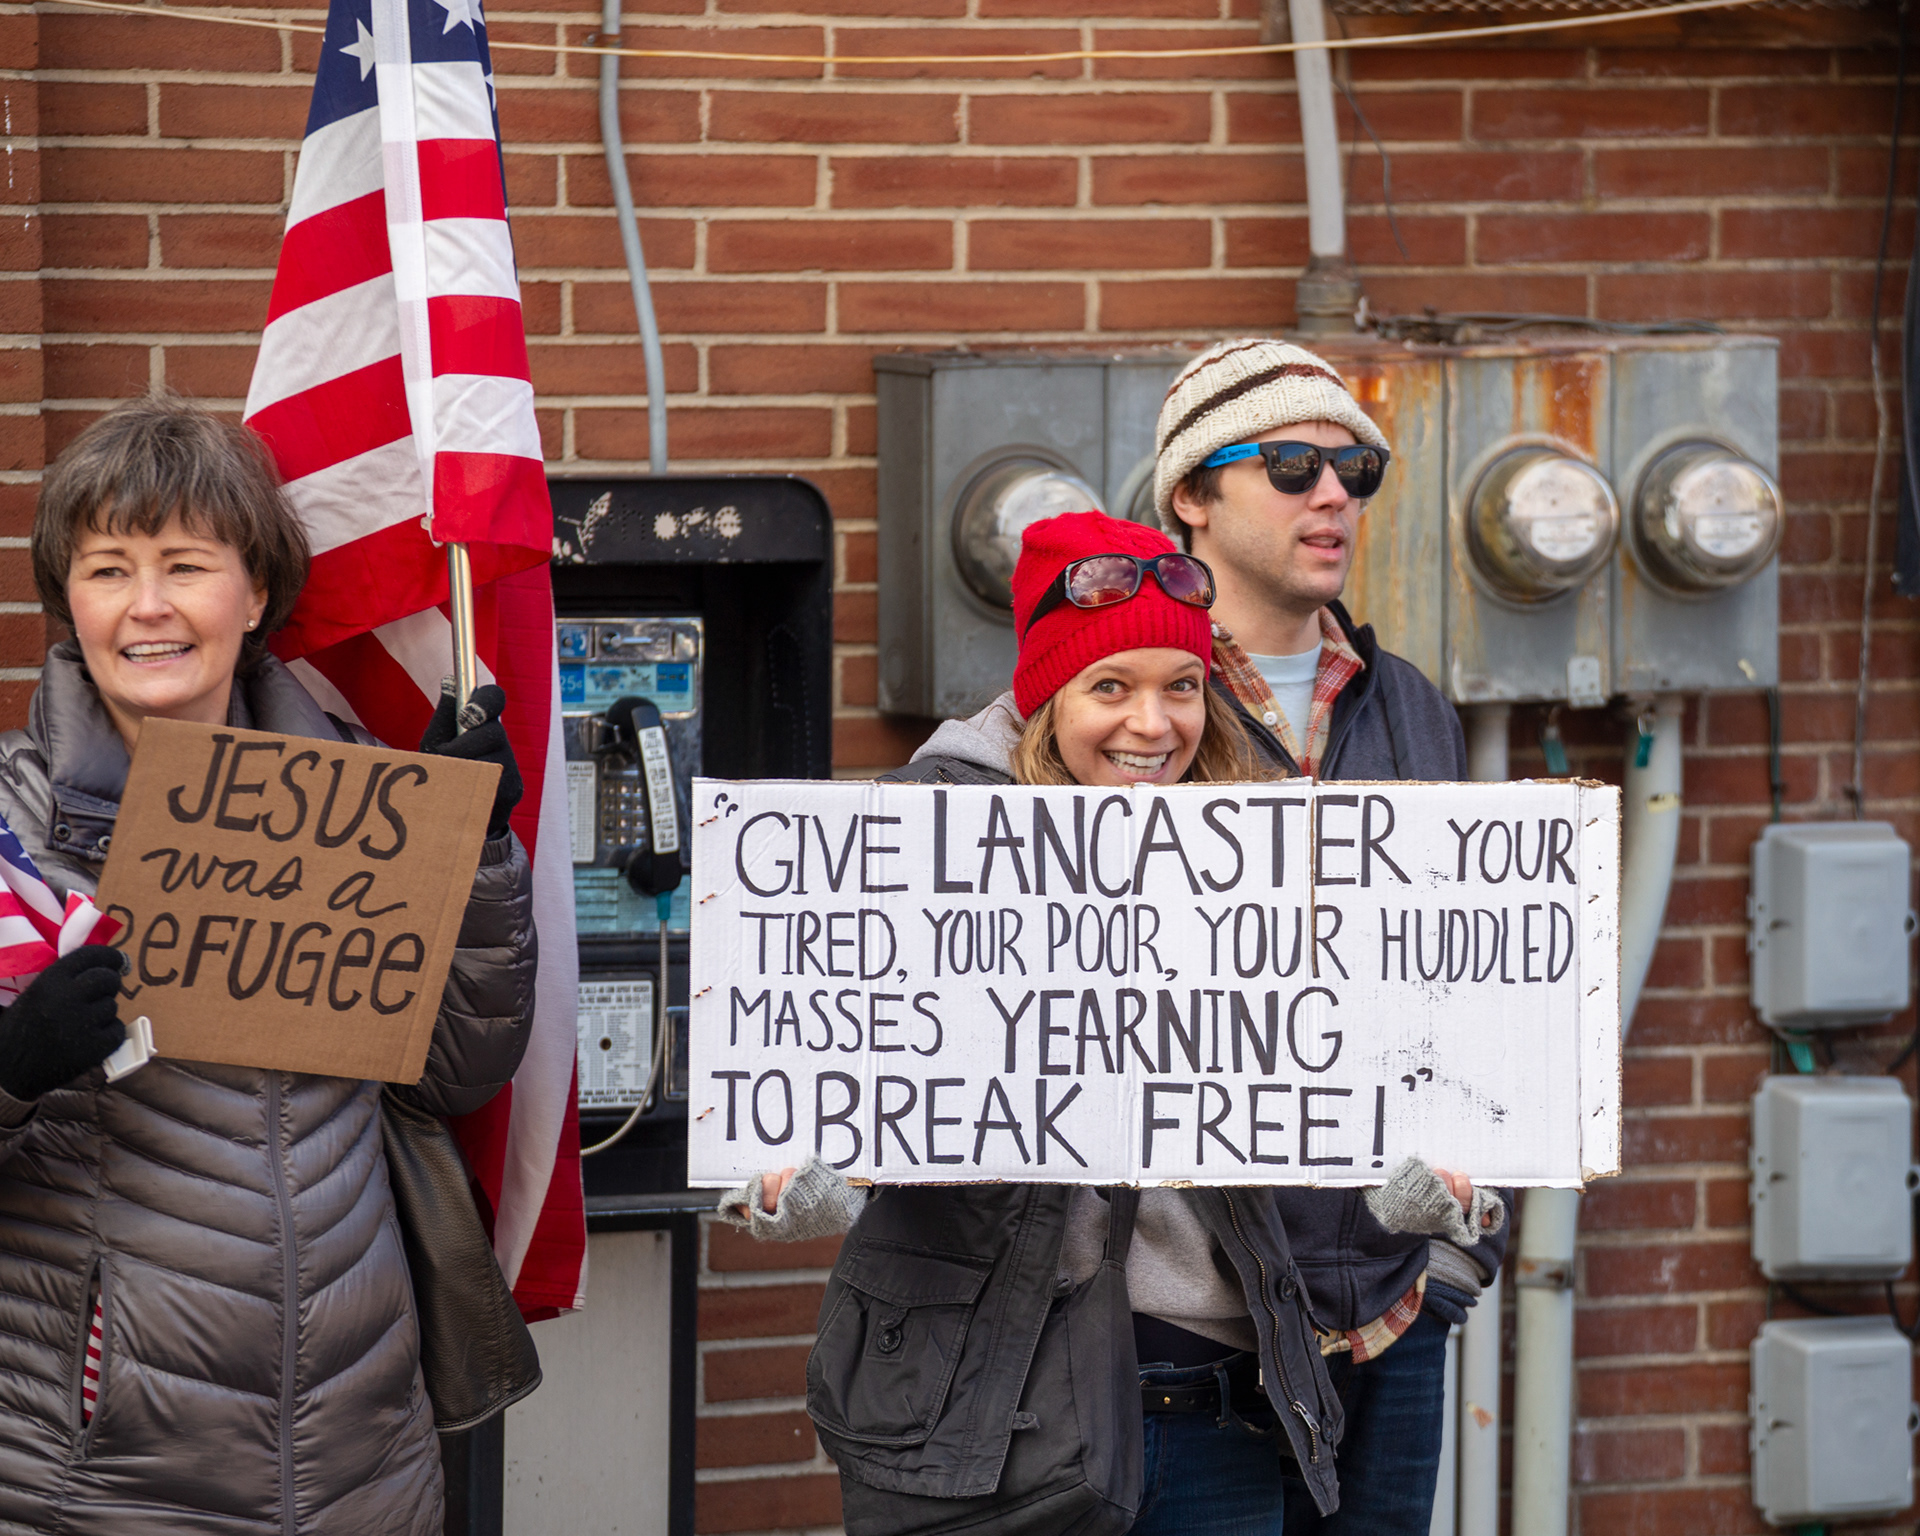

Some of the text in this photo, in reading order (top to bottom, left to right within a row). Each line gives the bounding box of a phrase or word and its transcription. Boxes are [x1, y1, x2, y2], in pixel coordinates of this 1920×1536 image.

[166, 733, 429, 861] JESUS
[932, 789, 1412, 898] LANCASTER
[1446, 817, 1577, 885] YOUR
[141, 847, 408, 919] was a
[739, 901, 1575, 984] TIRED, YOUR POOR, YOUR HUDDLED
[729, 986, 943, 1057] MASSES
[986, 986, 1343, 1076] YEARNING
[710, 1069, 794, 1146] TO
[815, 1070, 1088, 1170] BREAK
